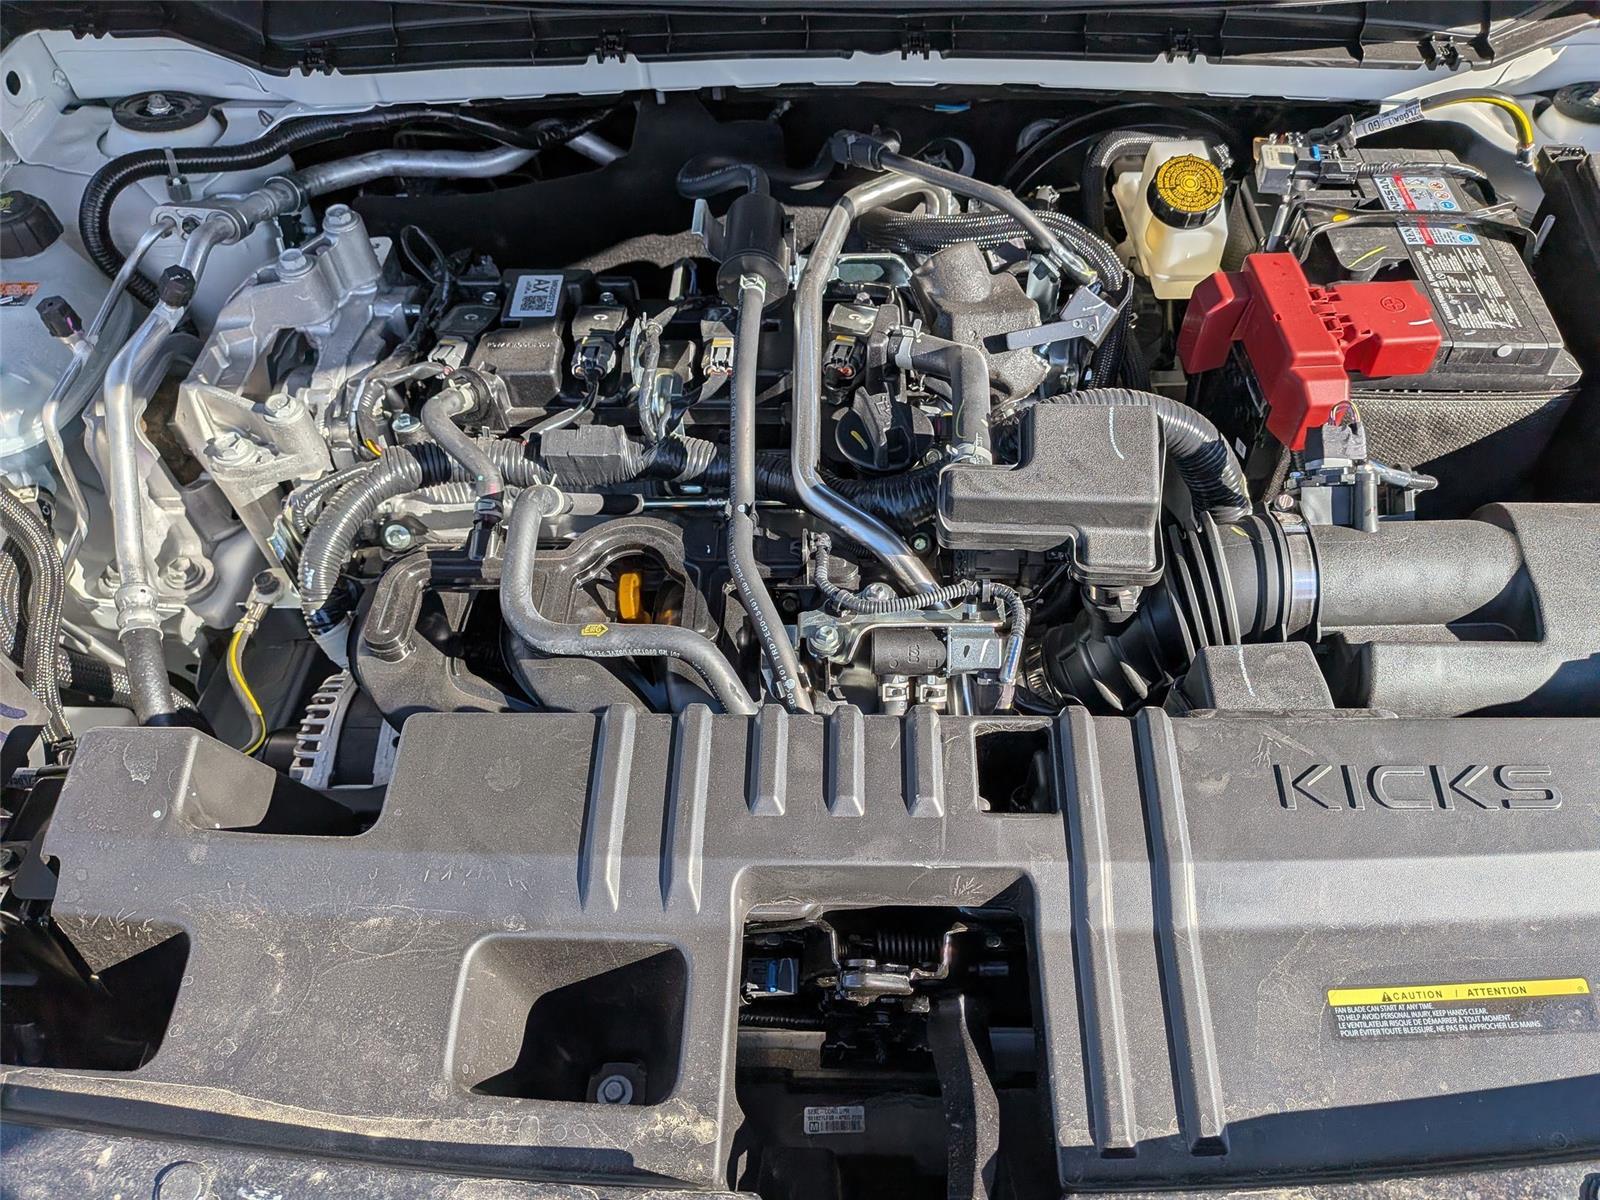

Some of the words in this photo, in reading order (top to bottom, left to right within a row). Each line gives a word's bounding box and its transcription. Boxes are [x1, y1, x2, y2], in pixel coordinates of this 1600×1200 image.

[1379, 177, 1402, 210] NISSAN
[531, 279, 551, 293] AX
[1272, 764, 1562, 811] KICKS
[1393, 990, 1443, 1001] CAUTION
[1467, 986, 1527, 997] ATTENTION
[1335, 1006, 1347, 1014] FAN
[1347, 1005, 1367, 1013] BLADE
[1367, 1005, 1380, 1013] CAN
[1381, 1004, 1398, 1012] START
[1337, 1014, 1345, 1022] TO
[1346, 1013, 1361, 1021] HELP
[1361, 1012, 1380, 1020] AVOID
[1380, 1011, 1410, 1019] PERSONAL
[1432, 1009, 1447, 1017] KEEP
[1447, 1008, 1468, 1016] HANDS
[1468, 1007, 1488, 1015] CLEAR.
[1338, 1022, 1346, 1030] LE
[1346, 1020, 1388, 1028] VENTILATEUR
[1389, 1019, 1413, 1027] RISQUE
[1413, 1018, 1422, 1026] DE
[1422, 1016, 1458, 1025] DÉMARRER
[1464, 1014, 1481, 1022] TOUT
[1482, 1013, 1513, 1022] MOMENT.
[1340, 1029, 1359, 1037] POUR
[1360, 1027, 1382, 1036] ÉVITER
[1382, 1027, 1402, 1035] TOUTE
[1403, 1025, 1436, 1034] BLESSURE,
[1437, 1024, 1445, 1032] NE
[1446, 1024, 1458, 1032] PAS
[1459, 1023, 1469, 1031] EN
[1469, 1021, 1507, 1031] APPROCHER
[1507, 1021, 1520, 1029] LES
[1520, 1020, 1543, 1028] MAINS.
